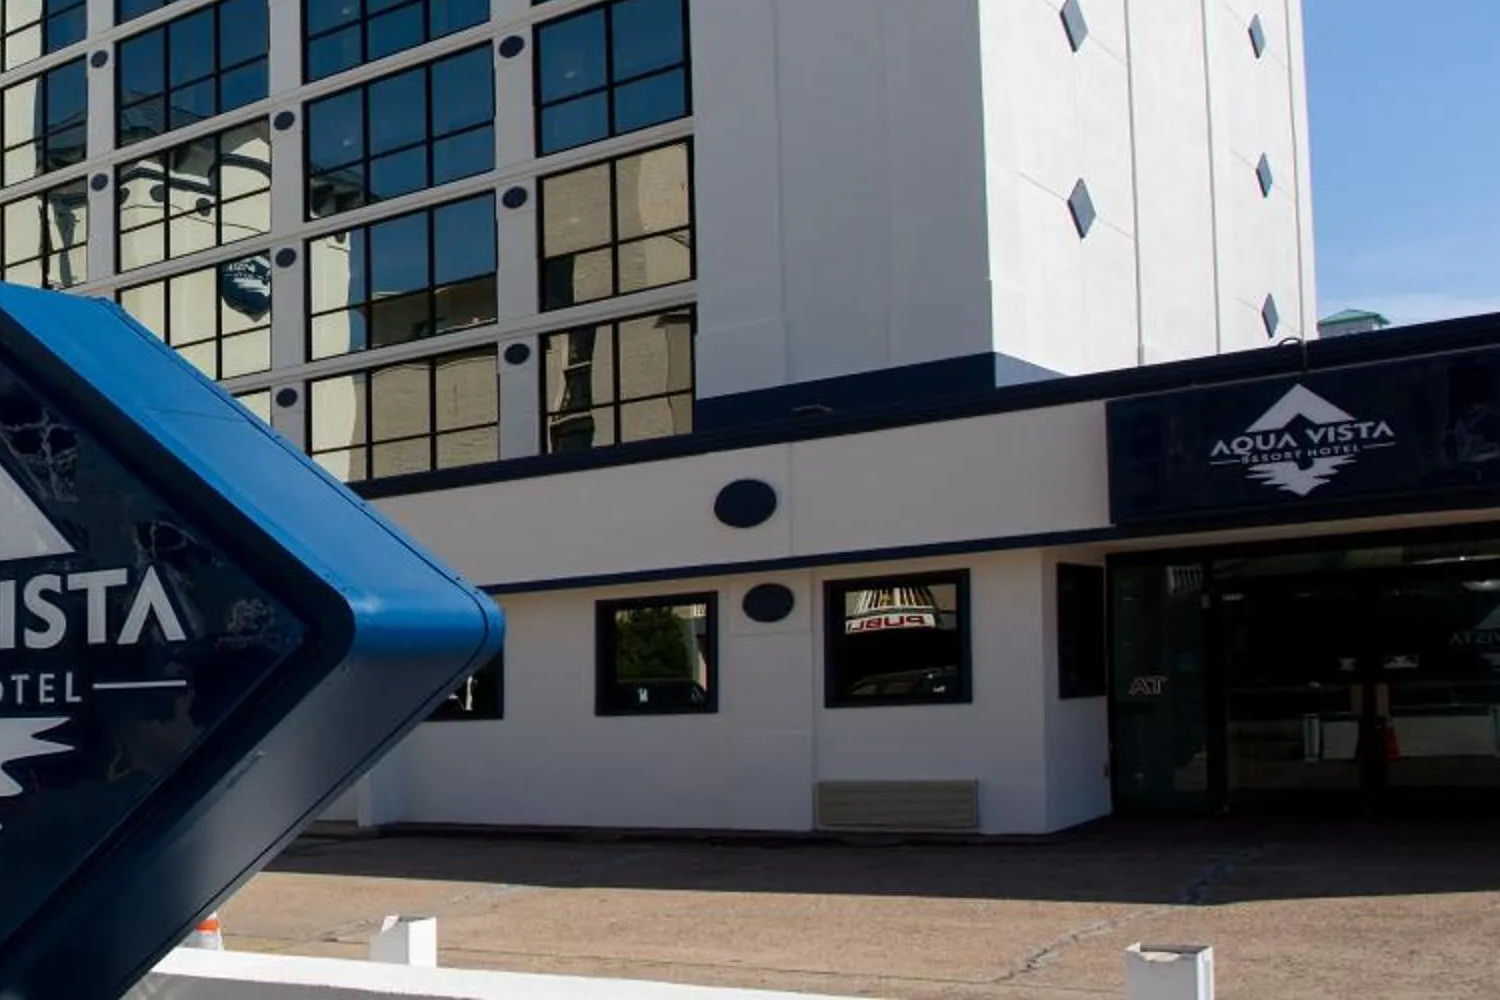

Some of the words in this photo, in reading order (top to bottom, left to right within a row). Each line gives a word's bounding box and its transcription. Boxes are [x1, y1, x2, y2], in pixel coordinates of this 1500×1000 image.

[1210, 431, 1298, 456] AQUA
[1305, 420, 1395, 445] VISTA
[1307, 444, 1361, 457] HOTEL
